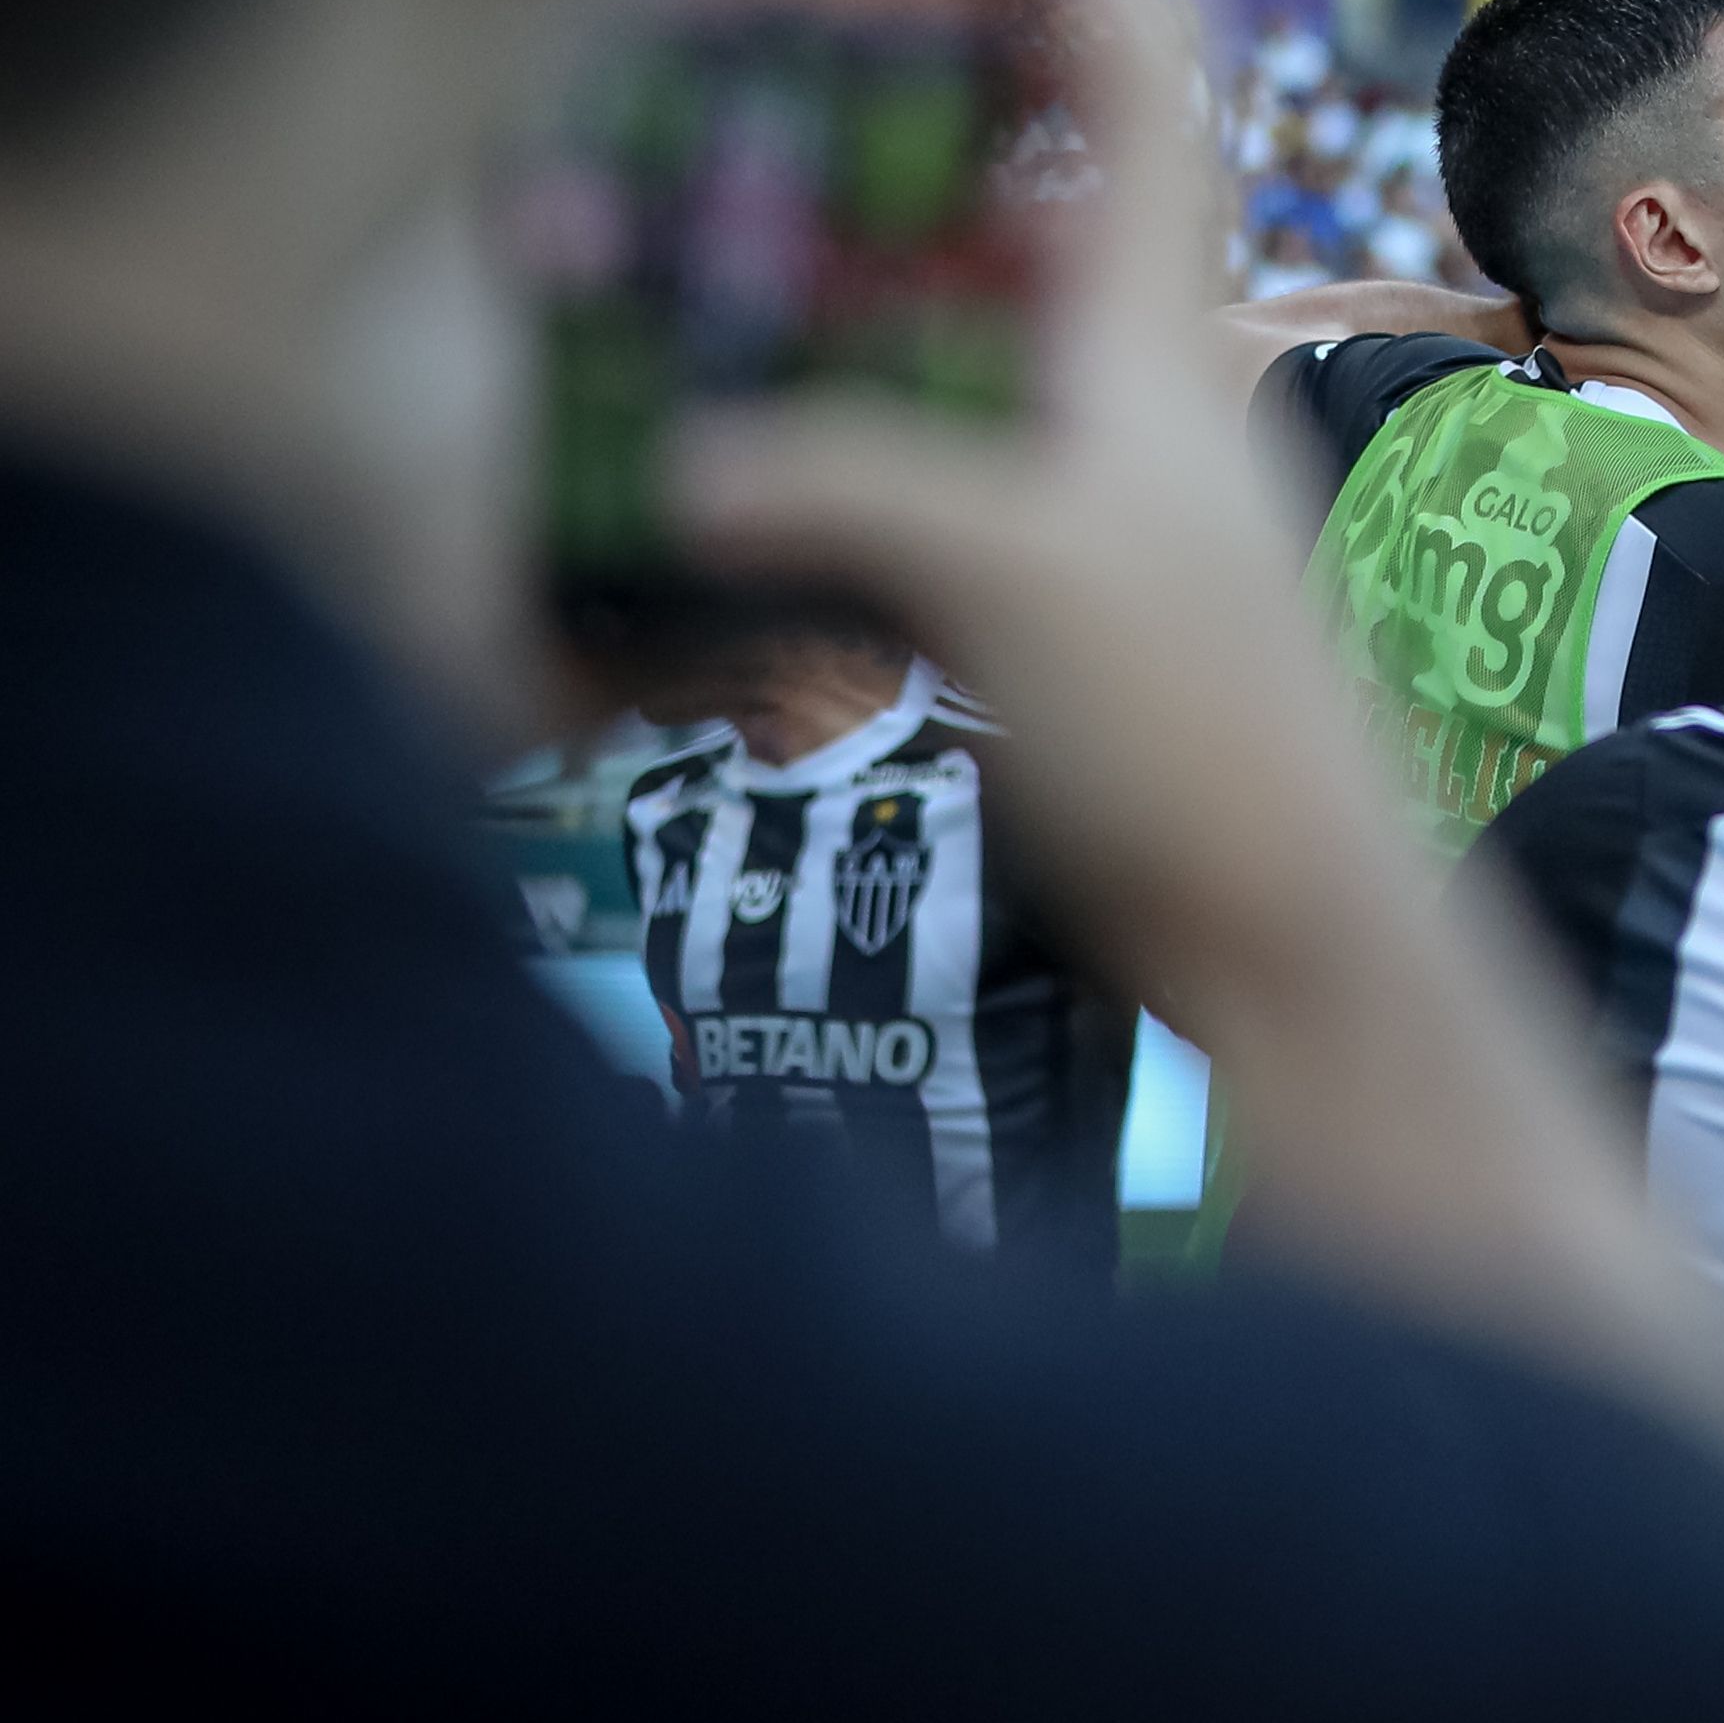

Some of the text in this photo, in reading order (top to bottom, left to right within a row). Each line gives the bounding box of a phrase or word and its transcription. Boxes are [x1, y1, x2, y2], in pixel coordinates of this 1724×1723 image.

[1474, 485, 1558, 537] GALO
[1402, 522, 1553, 694] mg
[696, 1016, 932, 1083] BETANO
